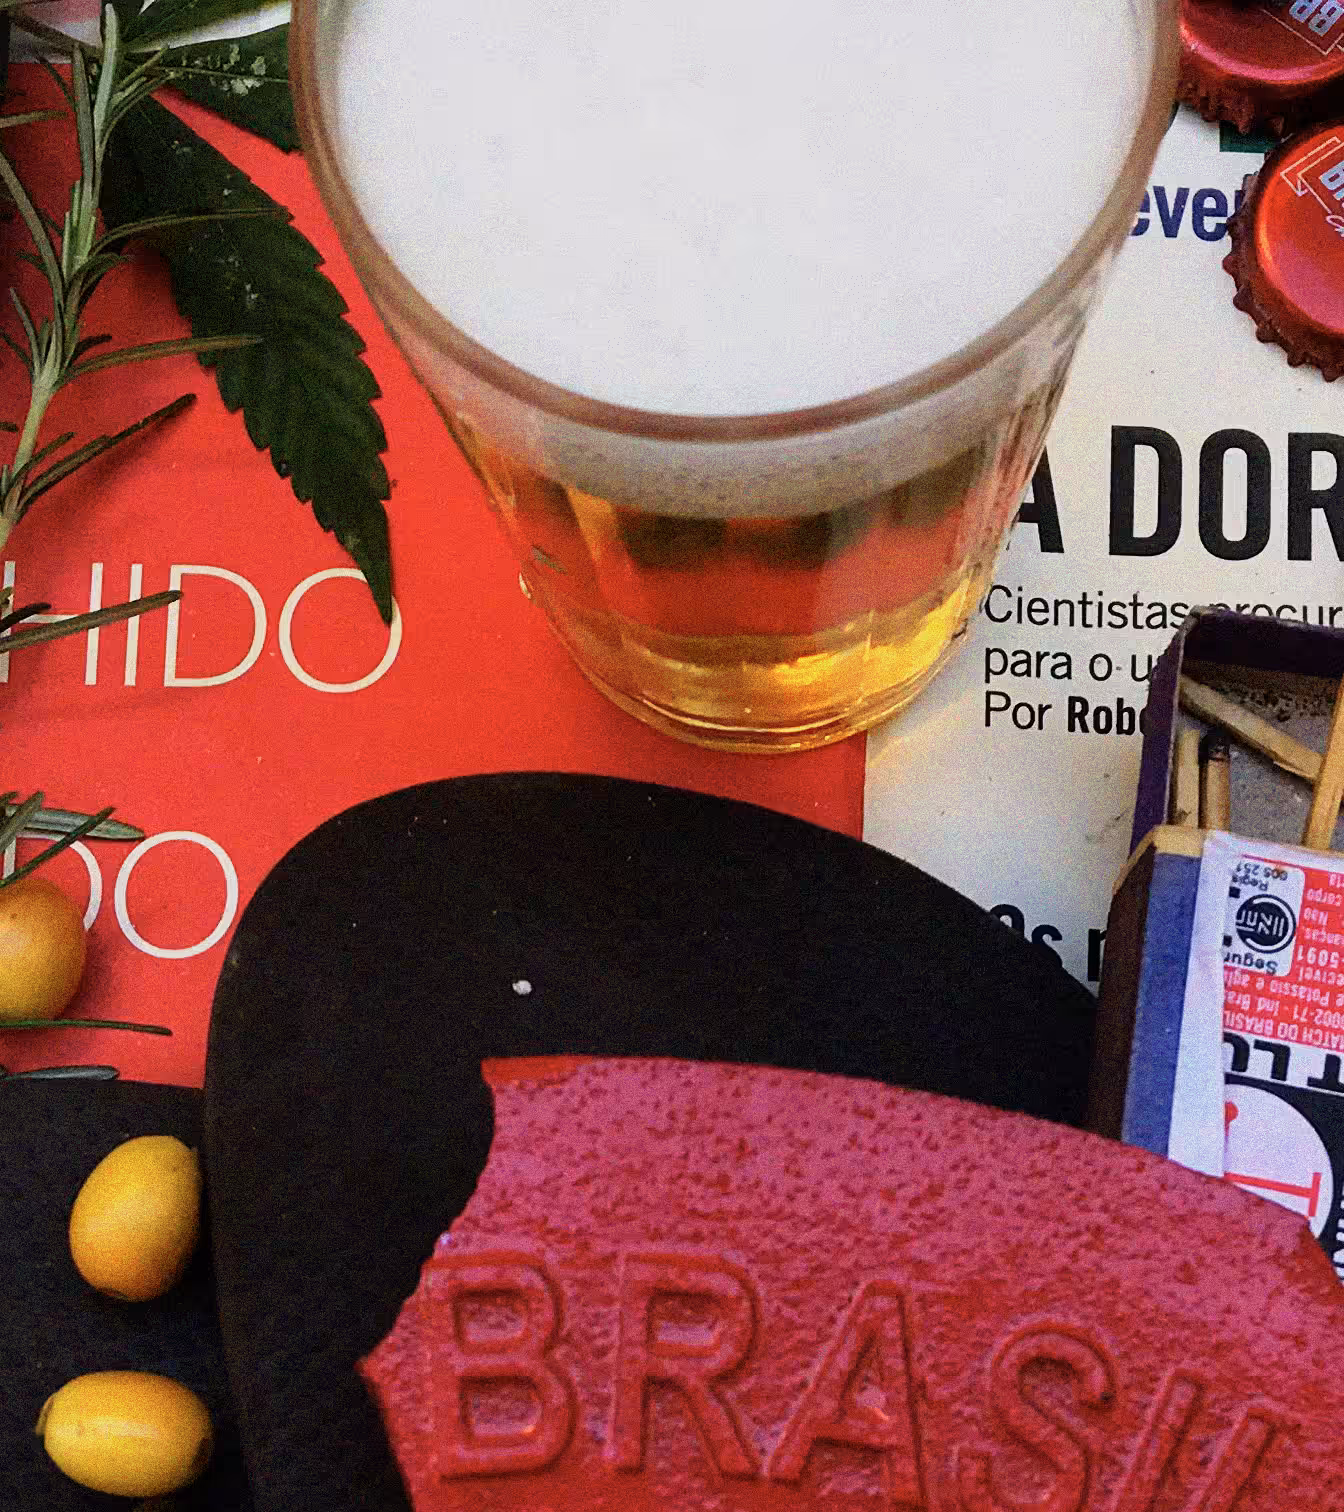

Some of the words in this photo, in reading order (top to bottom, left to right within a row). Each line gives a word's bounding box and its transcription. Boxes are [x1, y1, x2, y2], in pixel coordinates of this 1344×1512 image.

[984, 584, 1189, 630] Cientistas
[984, 645, 1073, 684] para
[1089, 652, 1113, 681] o
[984, 690, 1052, 732] Por
